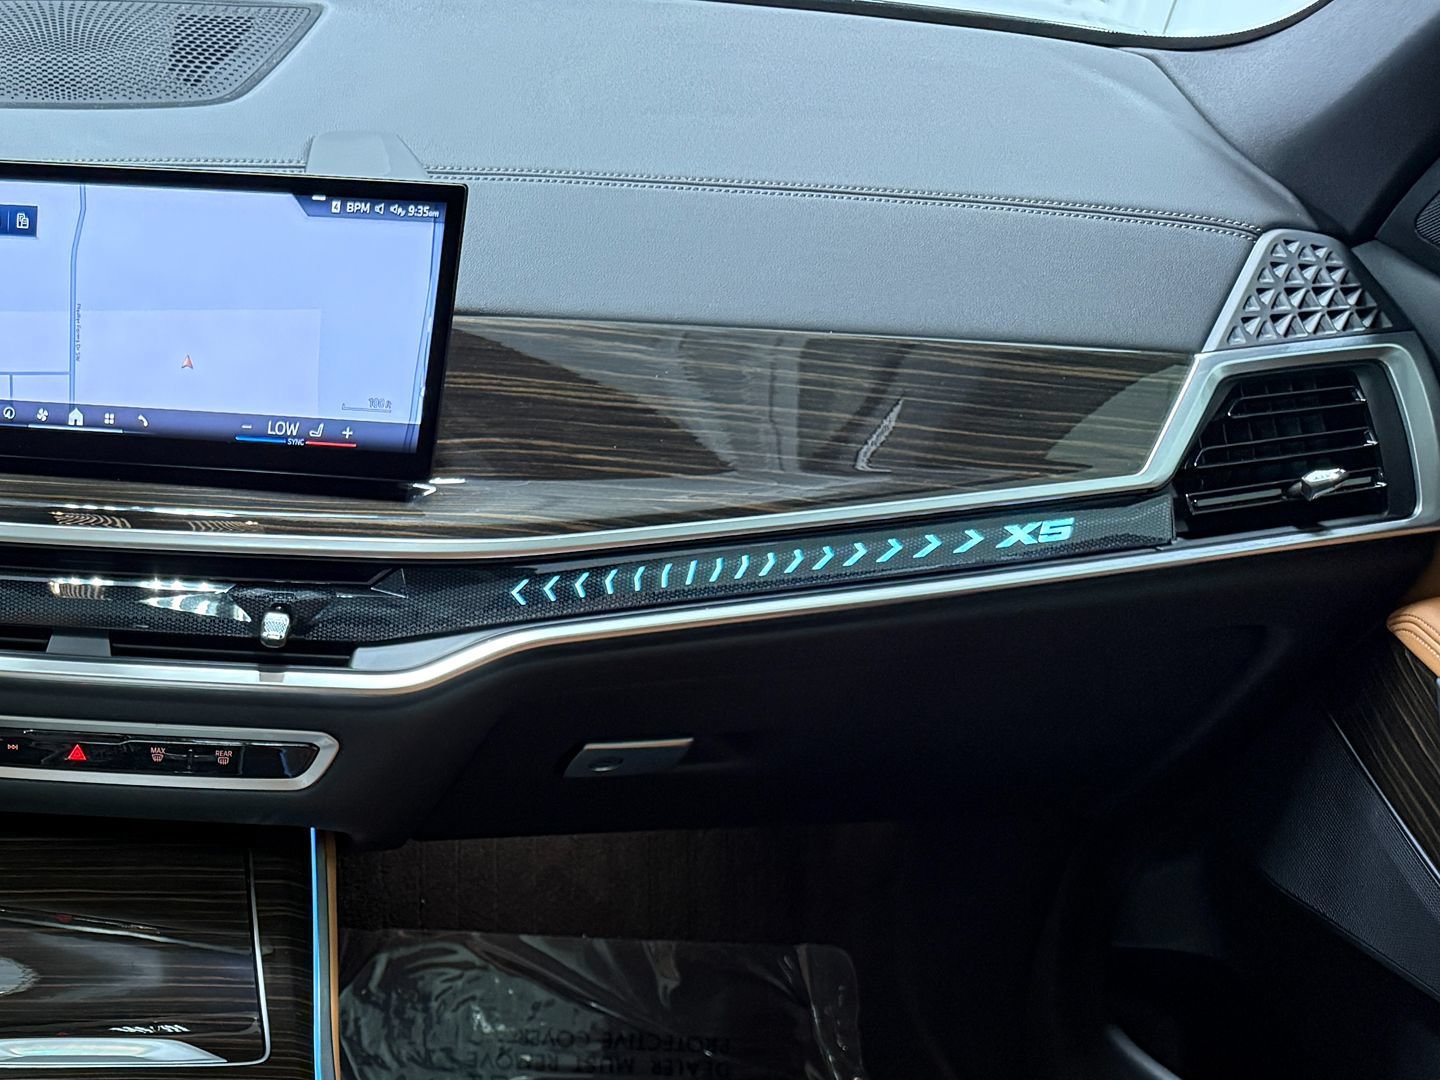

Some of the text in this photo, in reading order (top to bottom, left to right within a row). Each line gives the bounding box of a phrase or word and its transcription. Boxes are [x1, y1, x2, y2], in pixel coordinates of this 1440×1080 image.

[346, 201, 371, 214] BPM
[407, 205, 440, 218] 9:35am
[267, 419, 300, 436] LOW
[287, 438, 305, 447] SYNC
[995, 517, 1075, 549] X5
[150, 746, 166, 754] MAX
[215, 749, 233, 758] REAR
